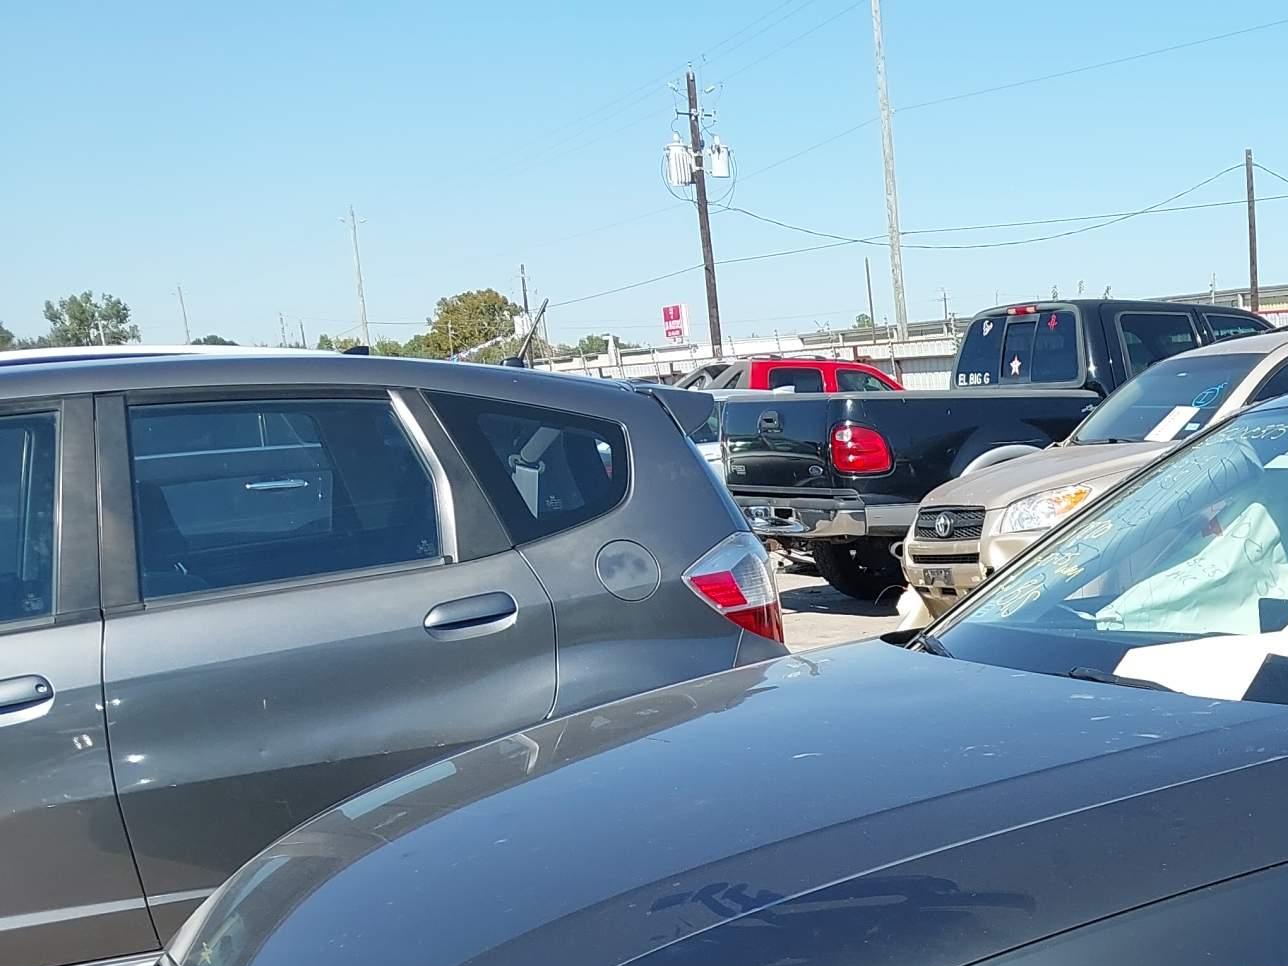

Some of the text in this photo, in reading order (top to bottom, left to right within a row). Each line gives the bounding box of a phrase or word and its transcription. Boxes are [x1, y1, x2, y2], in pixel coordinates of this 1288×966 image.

[958, 372, 990, 386] EL BIG G
